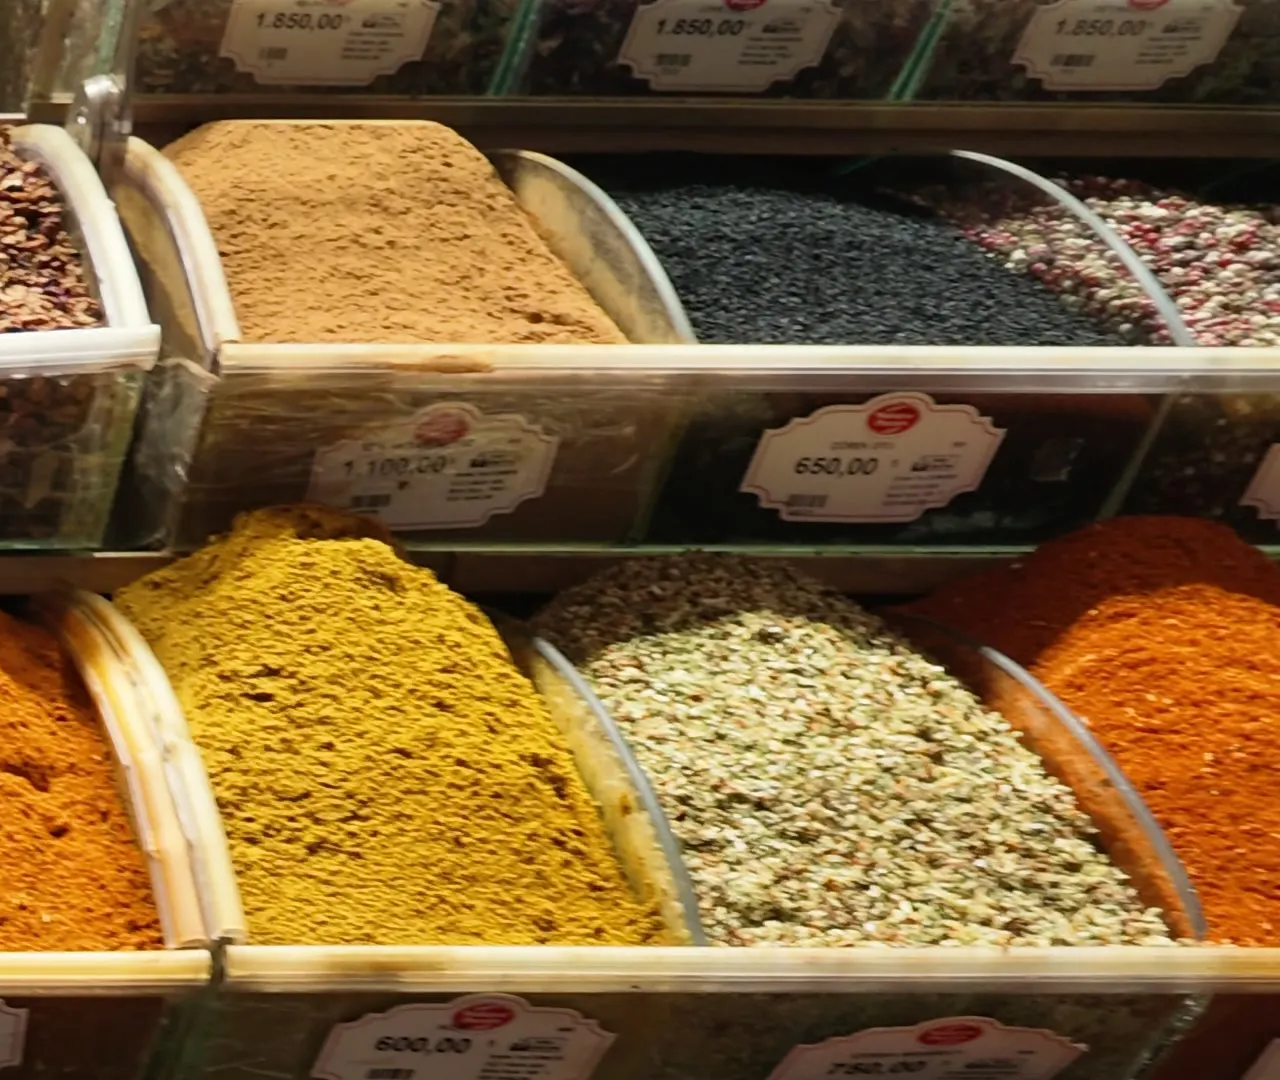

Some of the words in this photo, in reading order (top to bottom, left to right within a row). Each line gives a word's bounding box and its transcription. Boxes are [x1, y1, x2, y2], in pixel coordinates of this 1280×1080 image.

[257, 13, 343, 31] 1.850,00
[657, 19, 745, 37] 1.850,00
[1055, 19, 1146, 37] 1.850,00
[794, 457, 879, 476] 650,00
[374, 1036, 472, 1054] 600,00
